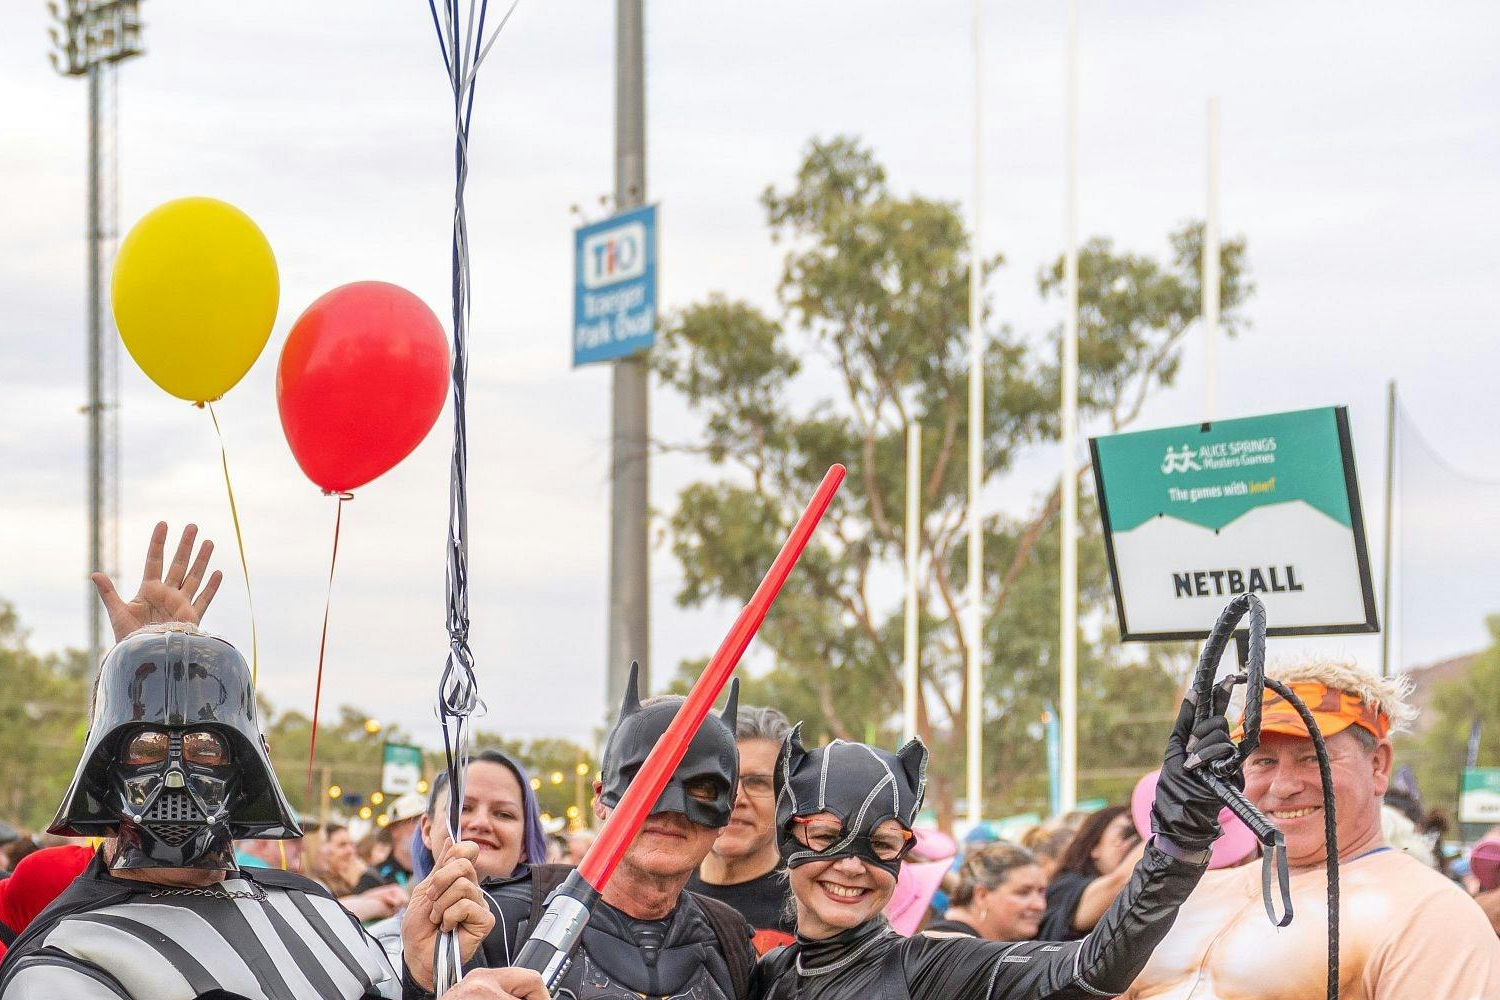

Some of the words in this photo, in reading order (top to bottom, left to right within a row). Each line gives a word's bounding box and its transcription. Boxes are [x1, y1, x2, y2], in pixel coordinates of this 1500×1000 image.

[1199, 443, 1227, 459] ALICE
[1228, 436, 1276, 454] SPRINGS
[1203, 456, 1240, 470] Masters
[1240, 453, 1275, 465] Games
[1168, 487, 1188, 501] The
[1190, 486, 1222, 503] games
[1223, 480, 1248, 496] with
[1173, 565, 1304, 598] NETBALL
